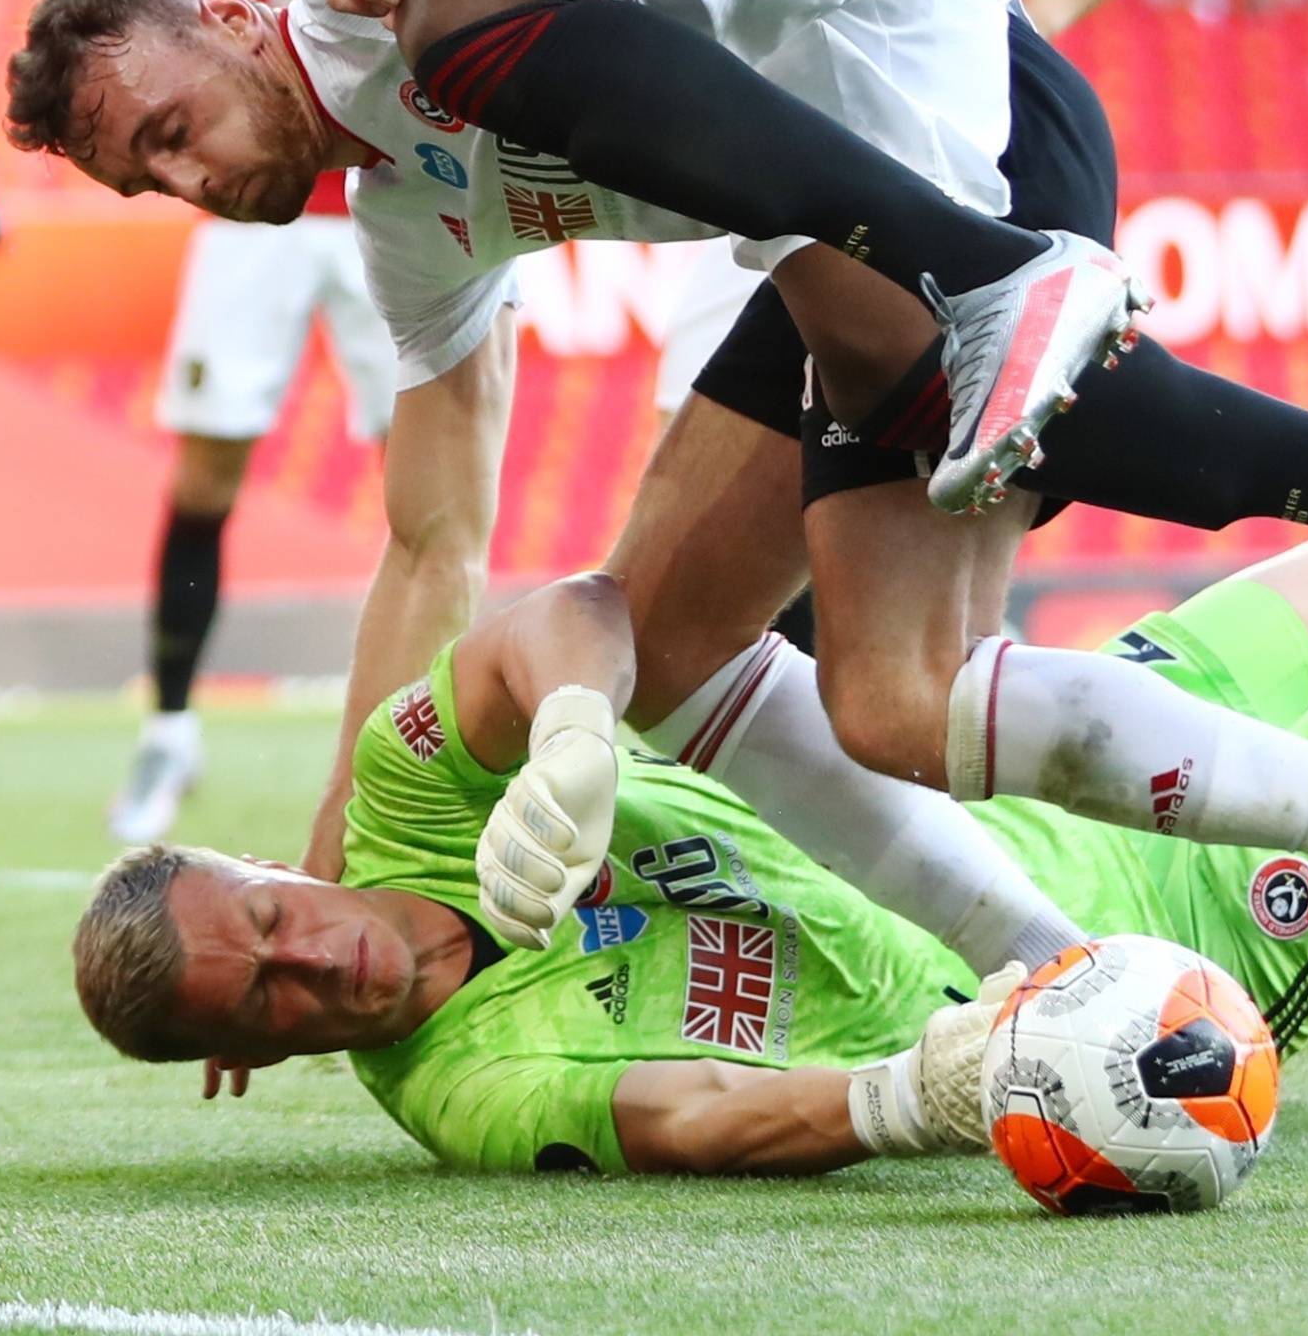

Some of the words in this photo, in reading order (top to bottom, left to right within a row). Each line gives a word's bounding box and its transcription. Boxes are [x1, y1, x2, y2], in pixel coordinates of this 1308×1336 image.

[715, 830, 760, 898] GROUP
[597, 906, 621, 947] NHS
[612, 962, 631, 1026] adidas
[770, 989, 793, 1062] UNION
